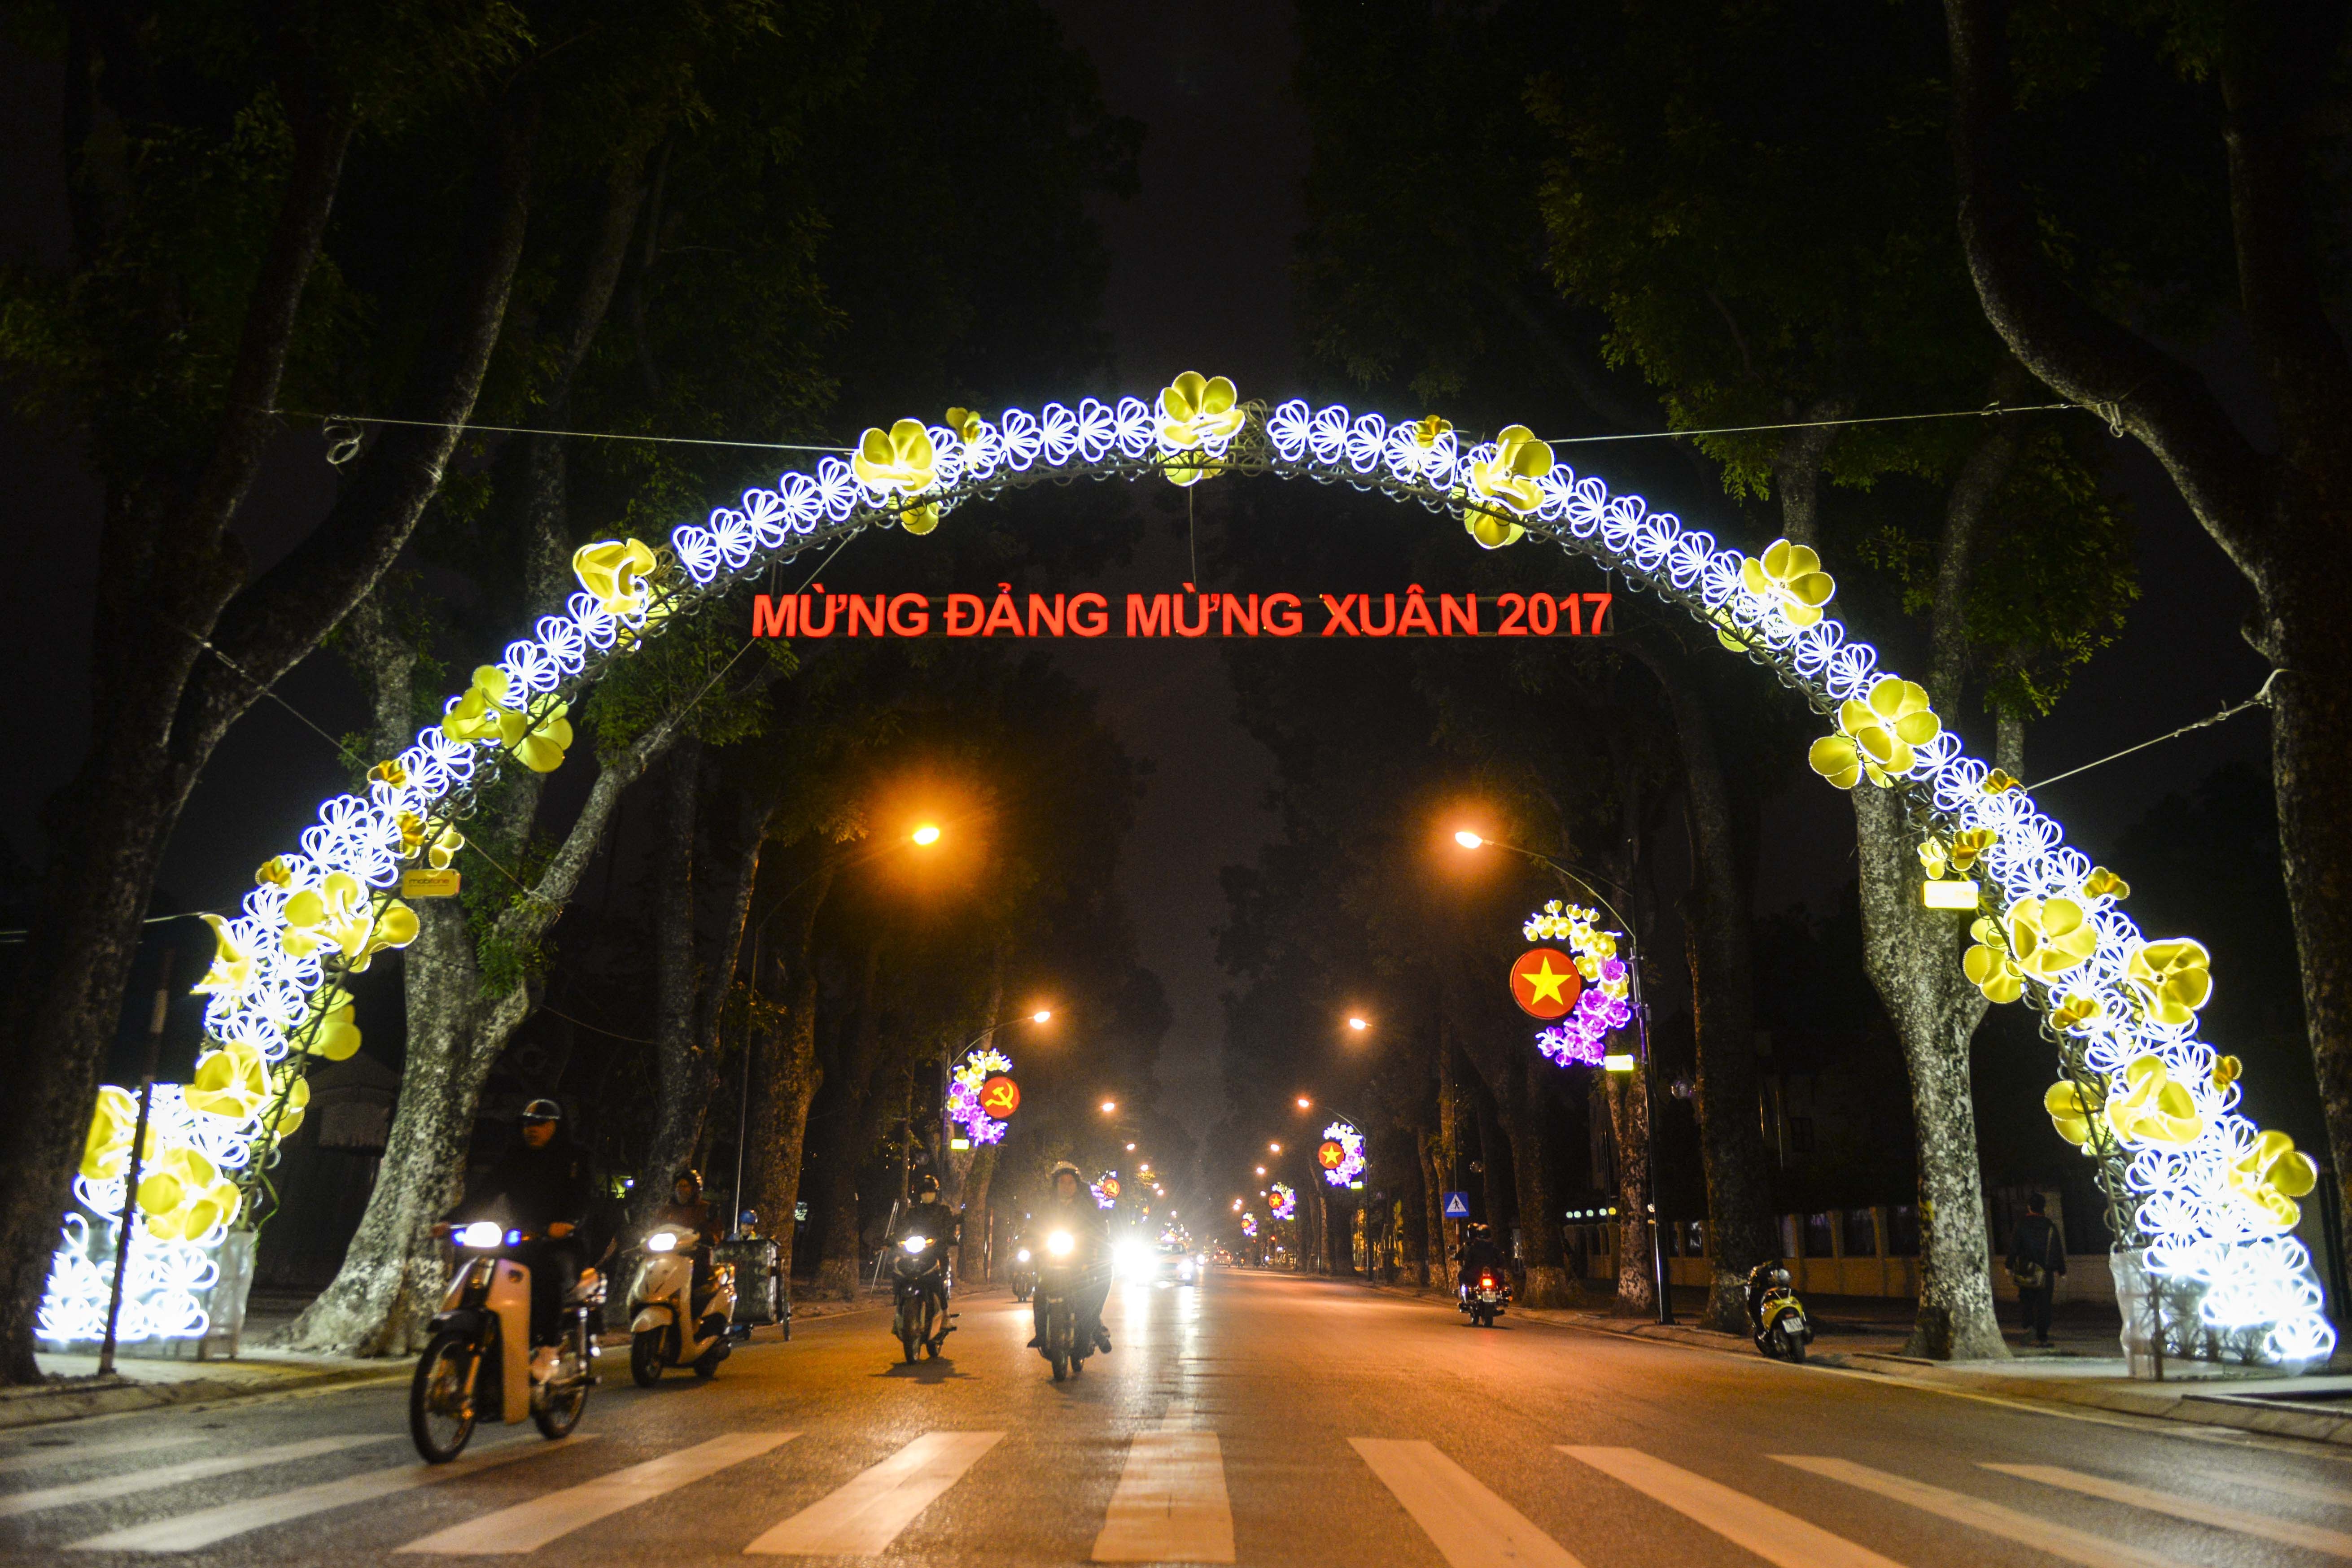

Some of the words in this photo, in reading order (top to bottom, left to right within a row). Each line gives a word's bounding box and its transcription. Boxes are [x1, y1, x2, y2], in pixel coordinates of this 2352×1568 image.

[752, 583, 929, 638] MỪNG
[943, 582, 1109, 637] ĐẢNG
[1127, 582, 1303, 638] MỪNG
[1319, 584, 1479, 637] XUÂN
[1497, 592, 1612, 636] 2017
